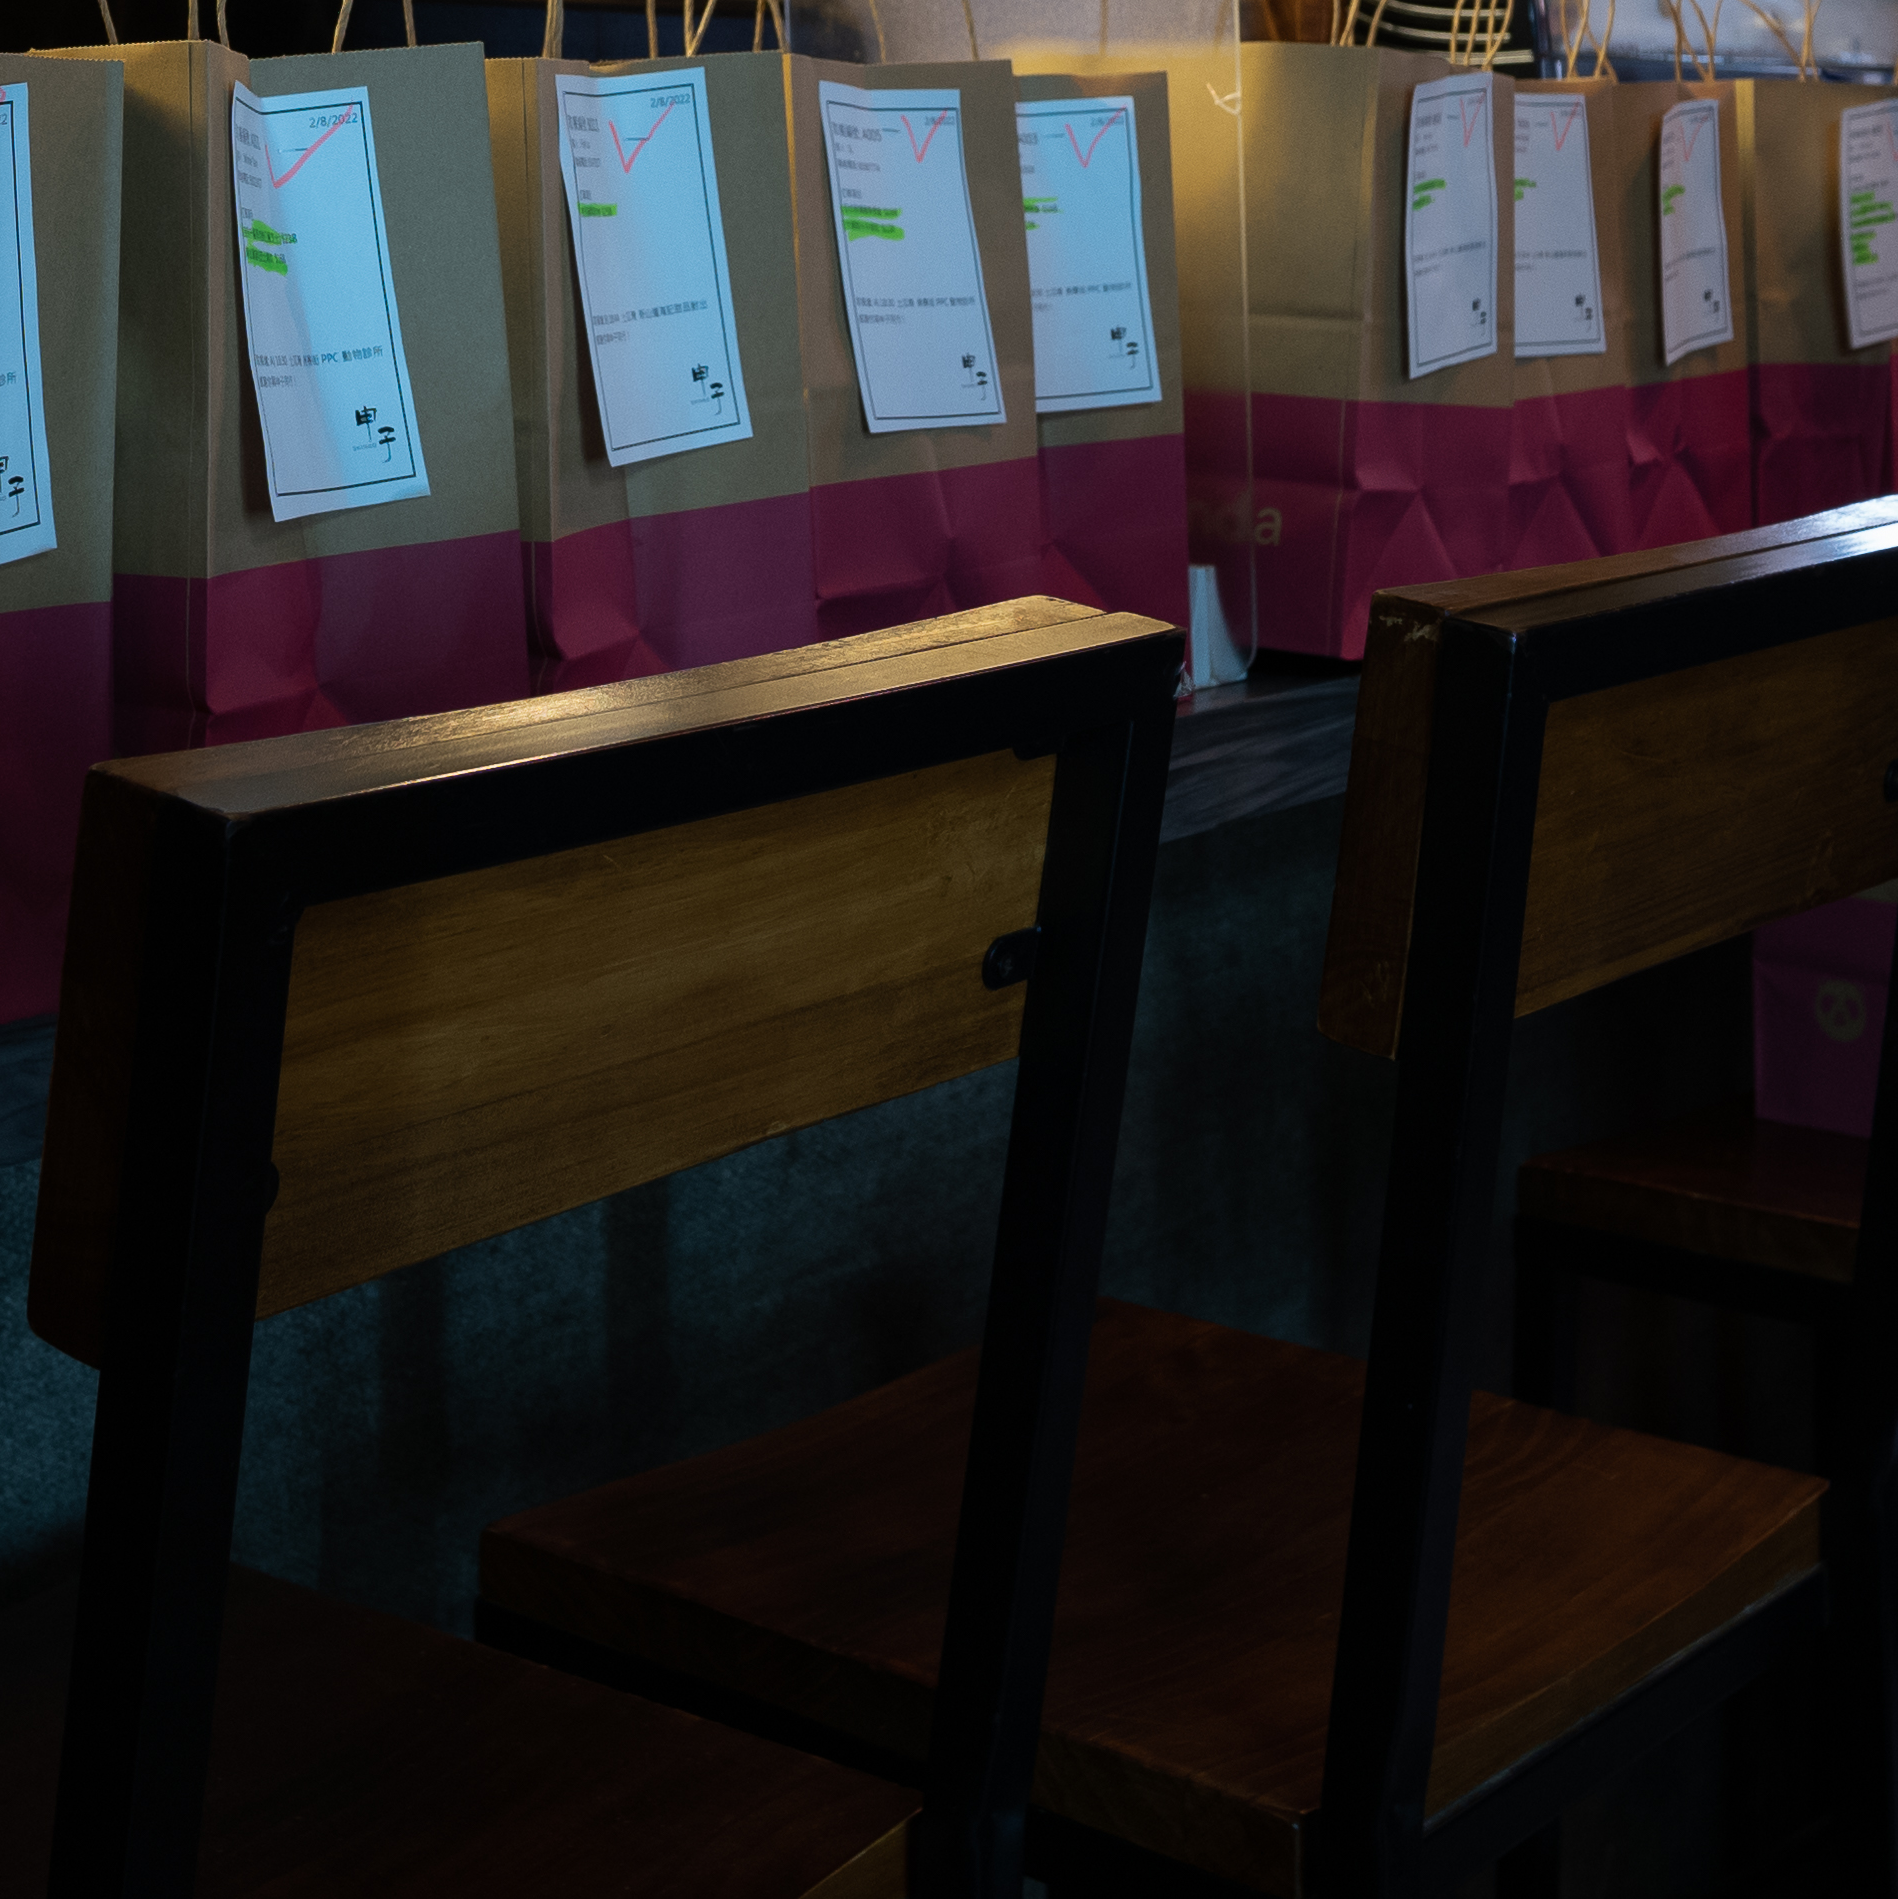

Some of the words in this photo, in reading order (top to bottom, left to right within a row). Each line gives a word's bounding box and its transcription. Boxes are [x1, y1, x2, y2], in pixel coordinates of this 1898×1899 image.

[308, 112, 358, 129] 2/8/2022
[321, 352, 338, 364] PPC
[691, 363, 725, 416] 申子
[355, 406, 396, 463] 申子
